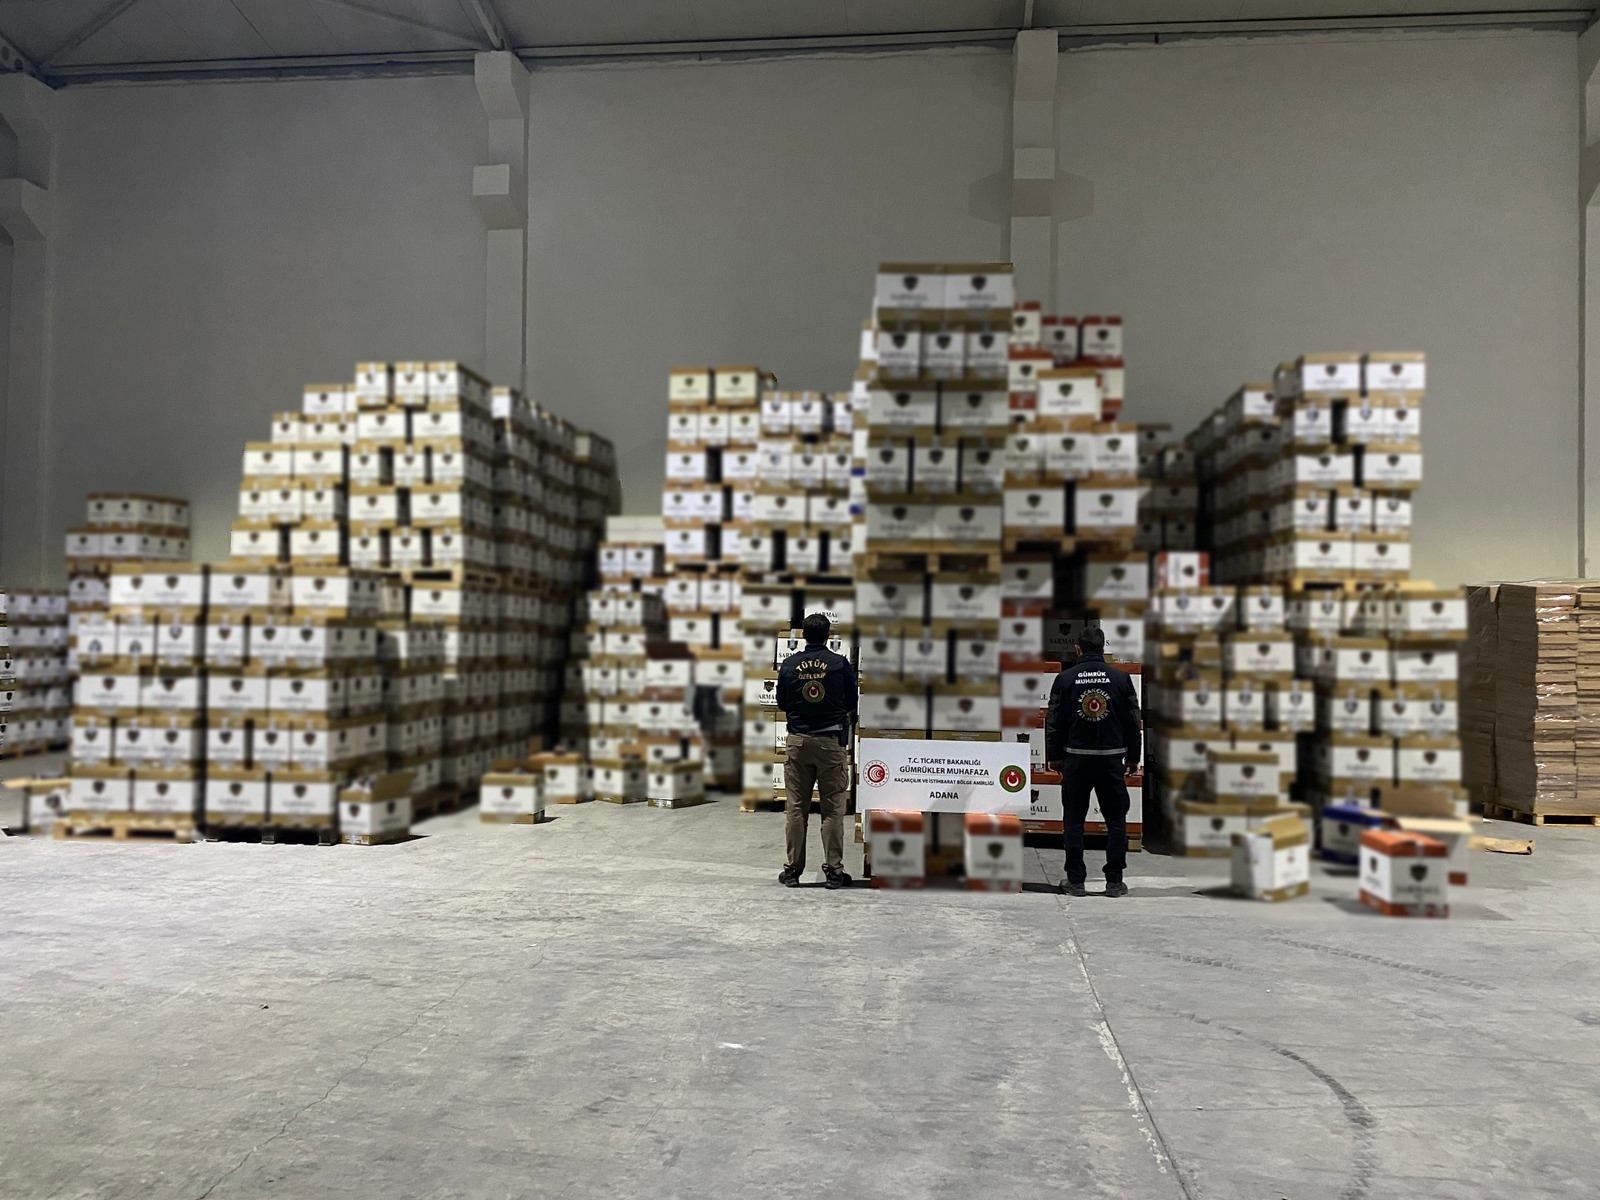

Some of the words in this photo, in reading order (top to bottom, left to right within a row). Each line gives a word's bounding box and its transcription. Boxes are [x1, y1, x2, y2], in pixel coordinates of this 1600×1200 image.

[795, 659, 828, 671] TÜTÜN
[1077, 670, 1107, 678] GÜMRÜK
[1075, 677, 1111, 685] MUHAFAZA
[919, 757, 946, 765] TİCARET
[899, 764, 946, 774] GÜMRÜKLER
[946, 767, 990, 776] MUHAFAZA
[929, 791, 959, 799] ADANA
